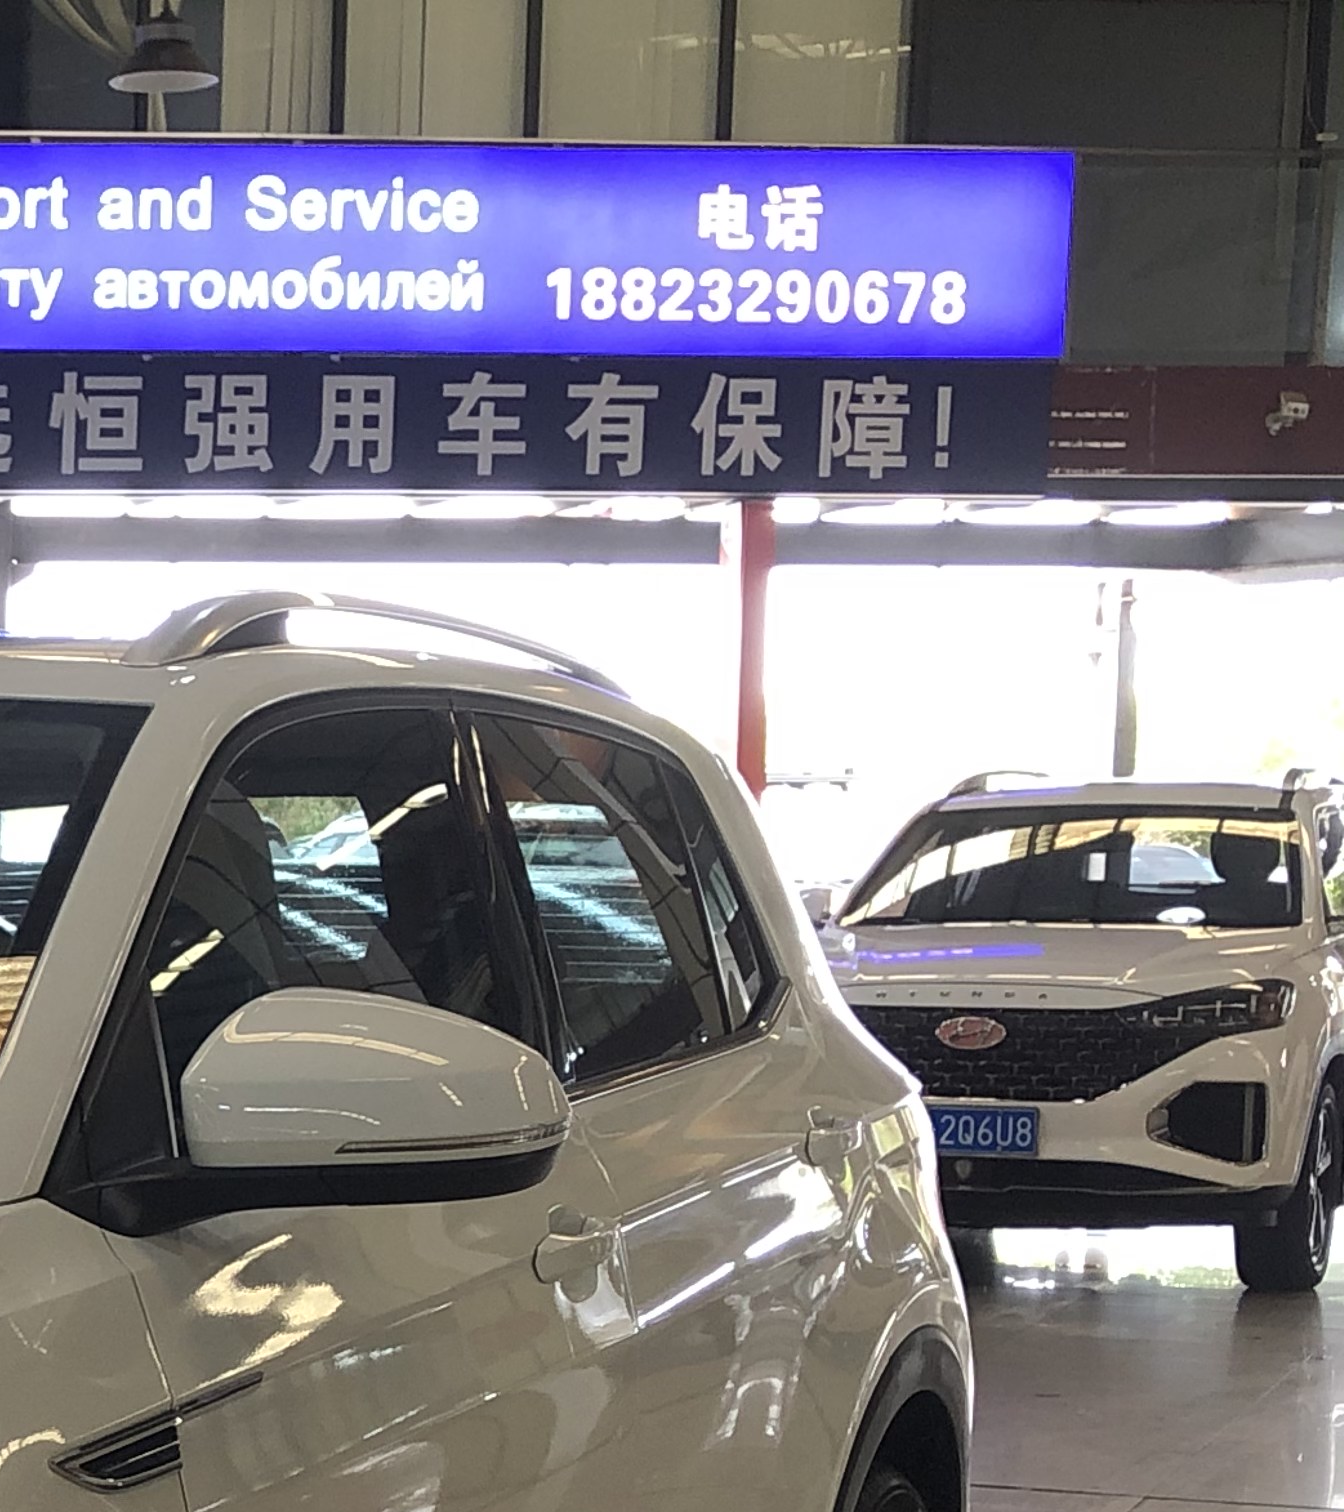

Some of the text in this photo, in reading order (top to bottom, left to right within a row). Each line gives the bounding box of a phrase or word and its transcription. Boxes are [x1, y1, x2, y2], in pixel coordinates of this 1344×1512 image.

[97, 176, 213, 232] and
[245, 174, 480, 233] Service
[697, 184, 824, 252] 电话
[93, 255, 485, 312] автомобилей
[546, 267, 968, 324] 18823290678
